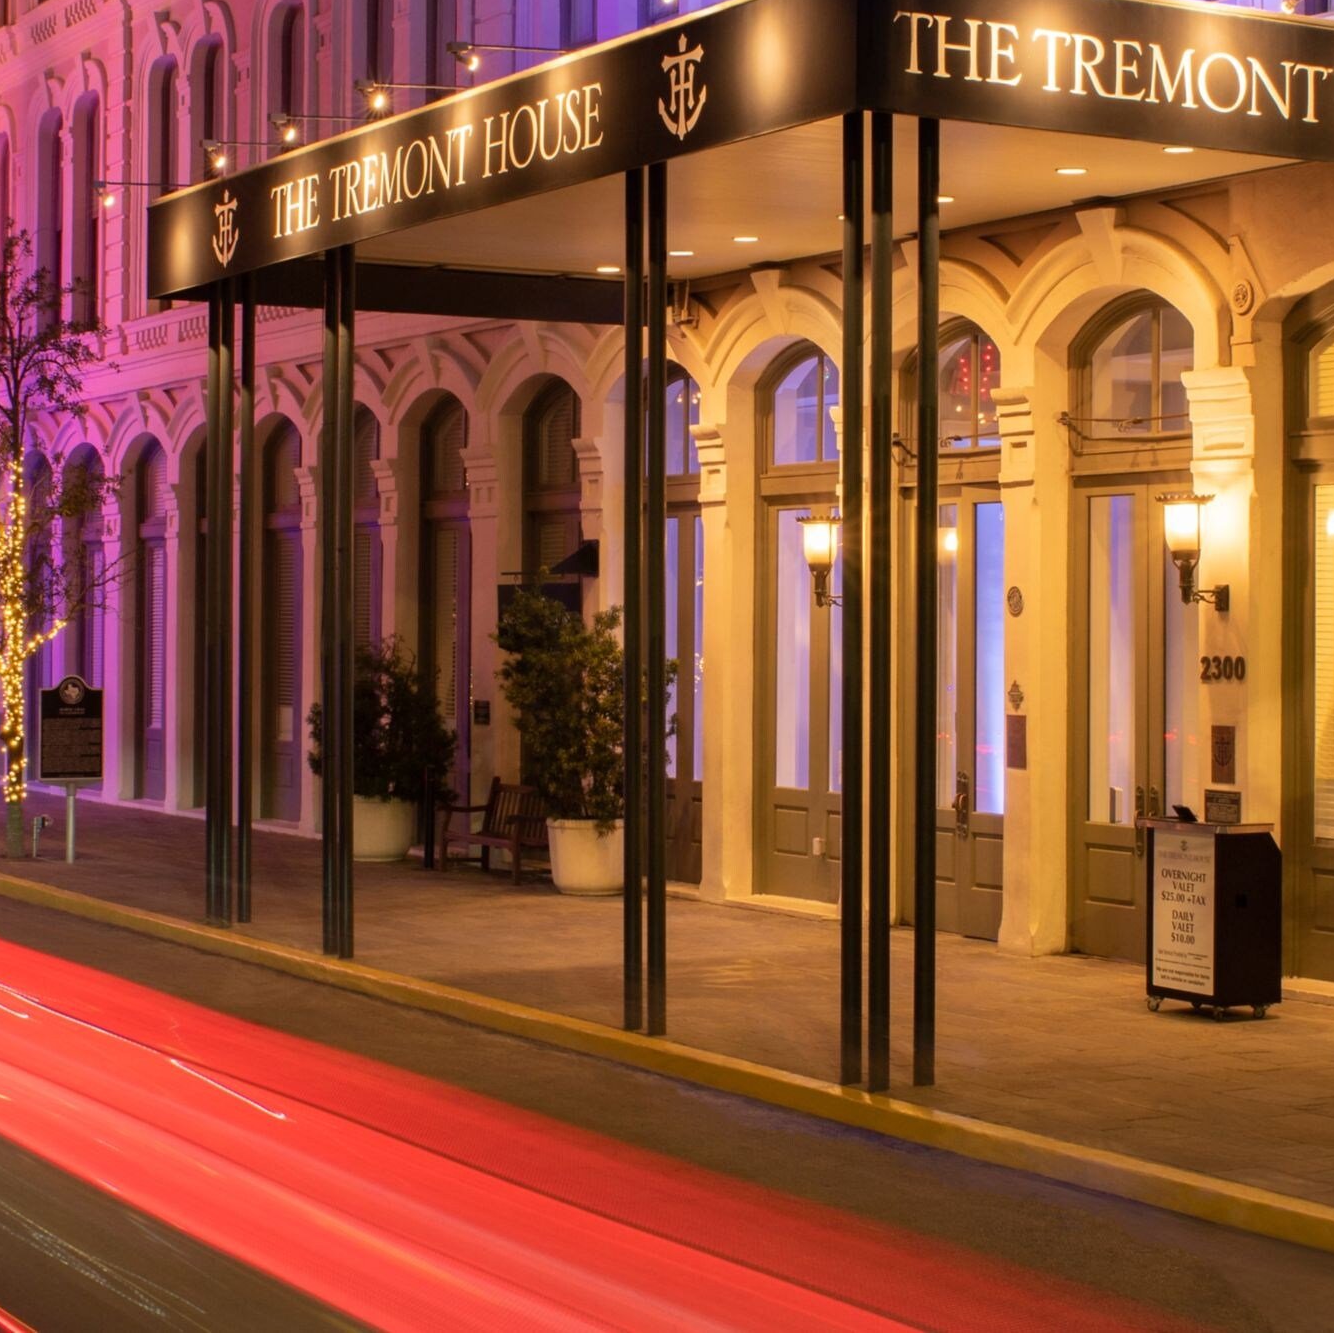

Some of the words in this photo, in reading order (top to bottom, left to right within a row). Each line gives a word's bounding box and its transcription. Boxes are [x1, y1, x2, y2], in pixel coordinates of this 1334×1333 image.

[893, 11, 1022, 86] THE
[1033, 28, 1331, 123] TREMONT
[271, 174, 320, 239] THE
[328, 124, 473, 222] TREMONT
[483, 83, 603, 179] HOUSE
[1200, 655, 1246, 682] 2300
[1161, 868, 1206, 883] OVERNIGHT
[1172, 881, 1195, 893] VALET
[1161, 890, 1185, 904] $25.00
[1172, 909, 1195, 922] DAILY
[1171, 921, 1194, 934] VALET
[1171, 932, 1195, 945] $10.00
